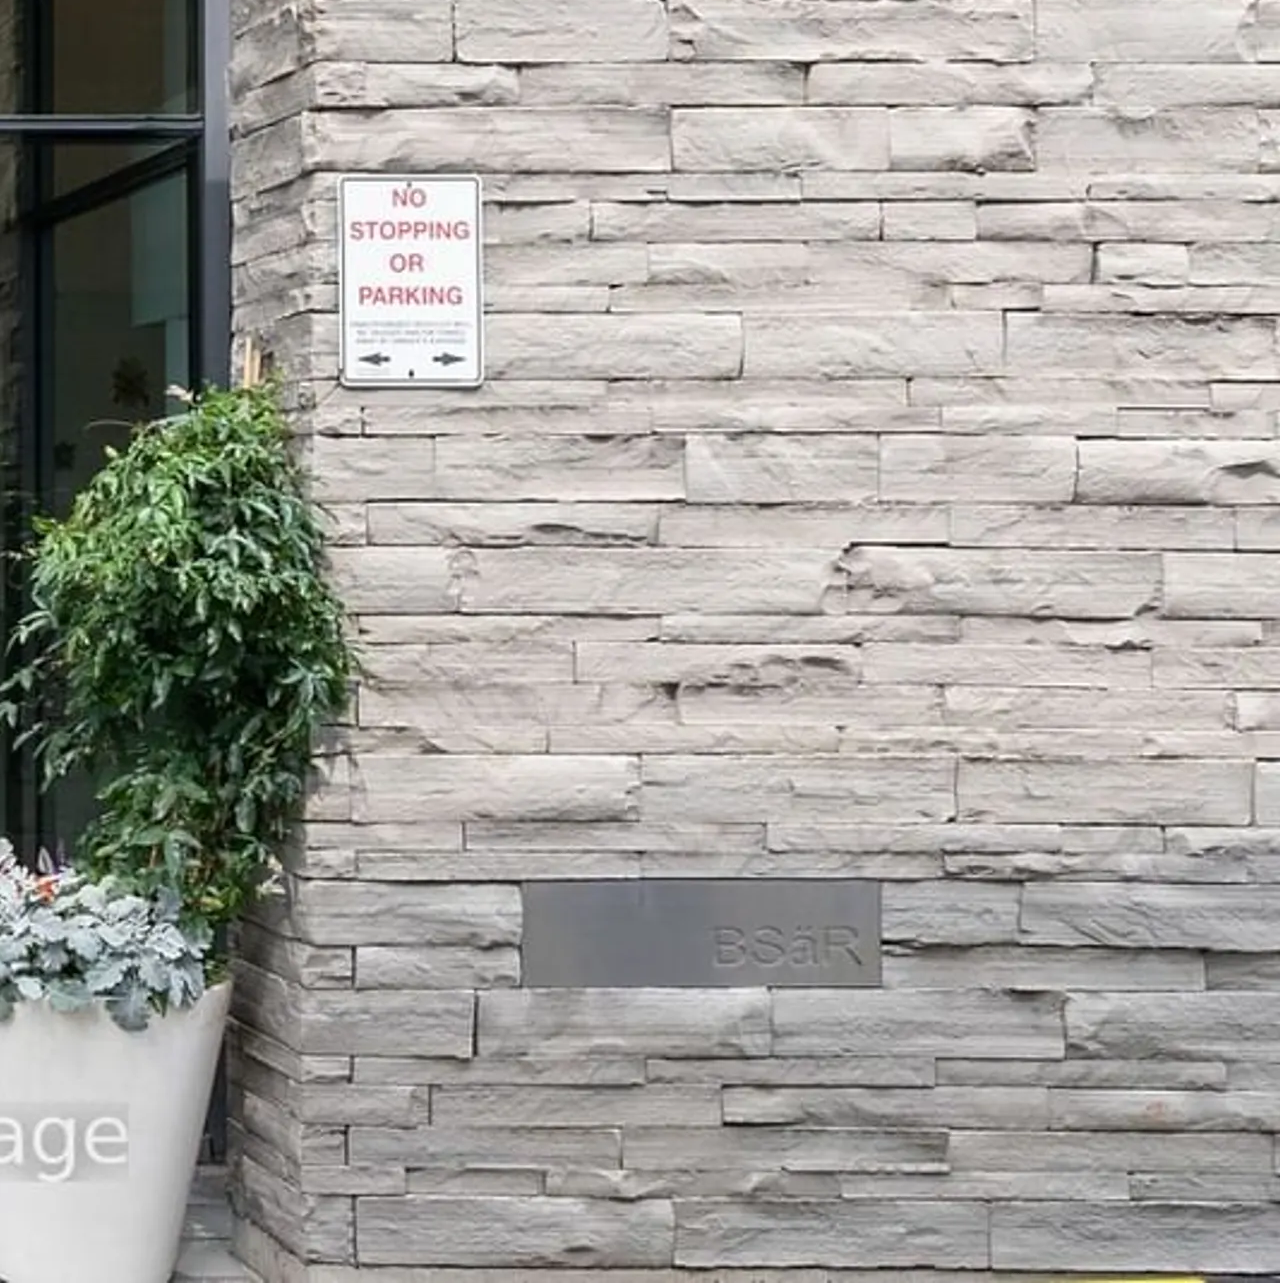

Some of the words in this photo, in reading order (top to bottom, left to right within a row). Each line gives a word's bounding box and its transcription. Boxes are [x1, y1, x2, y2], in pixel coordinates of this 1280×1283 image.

[391, 188, 427, 208] NO
[349, 220, 471, 241] STOPPING
[389, 252, 424, 273] OR
[357, 285, 464, 307] PARKING
